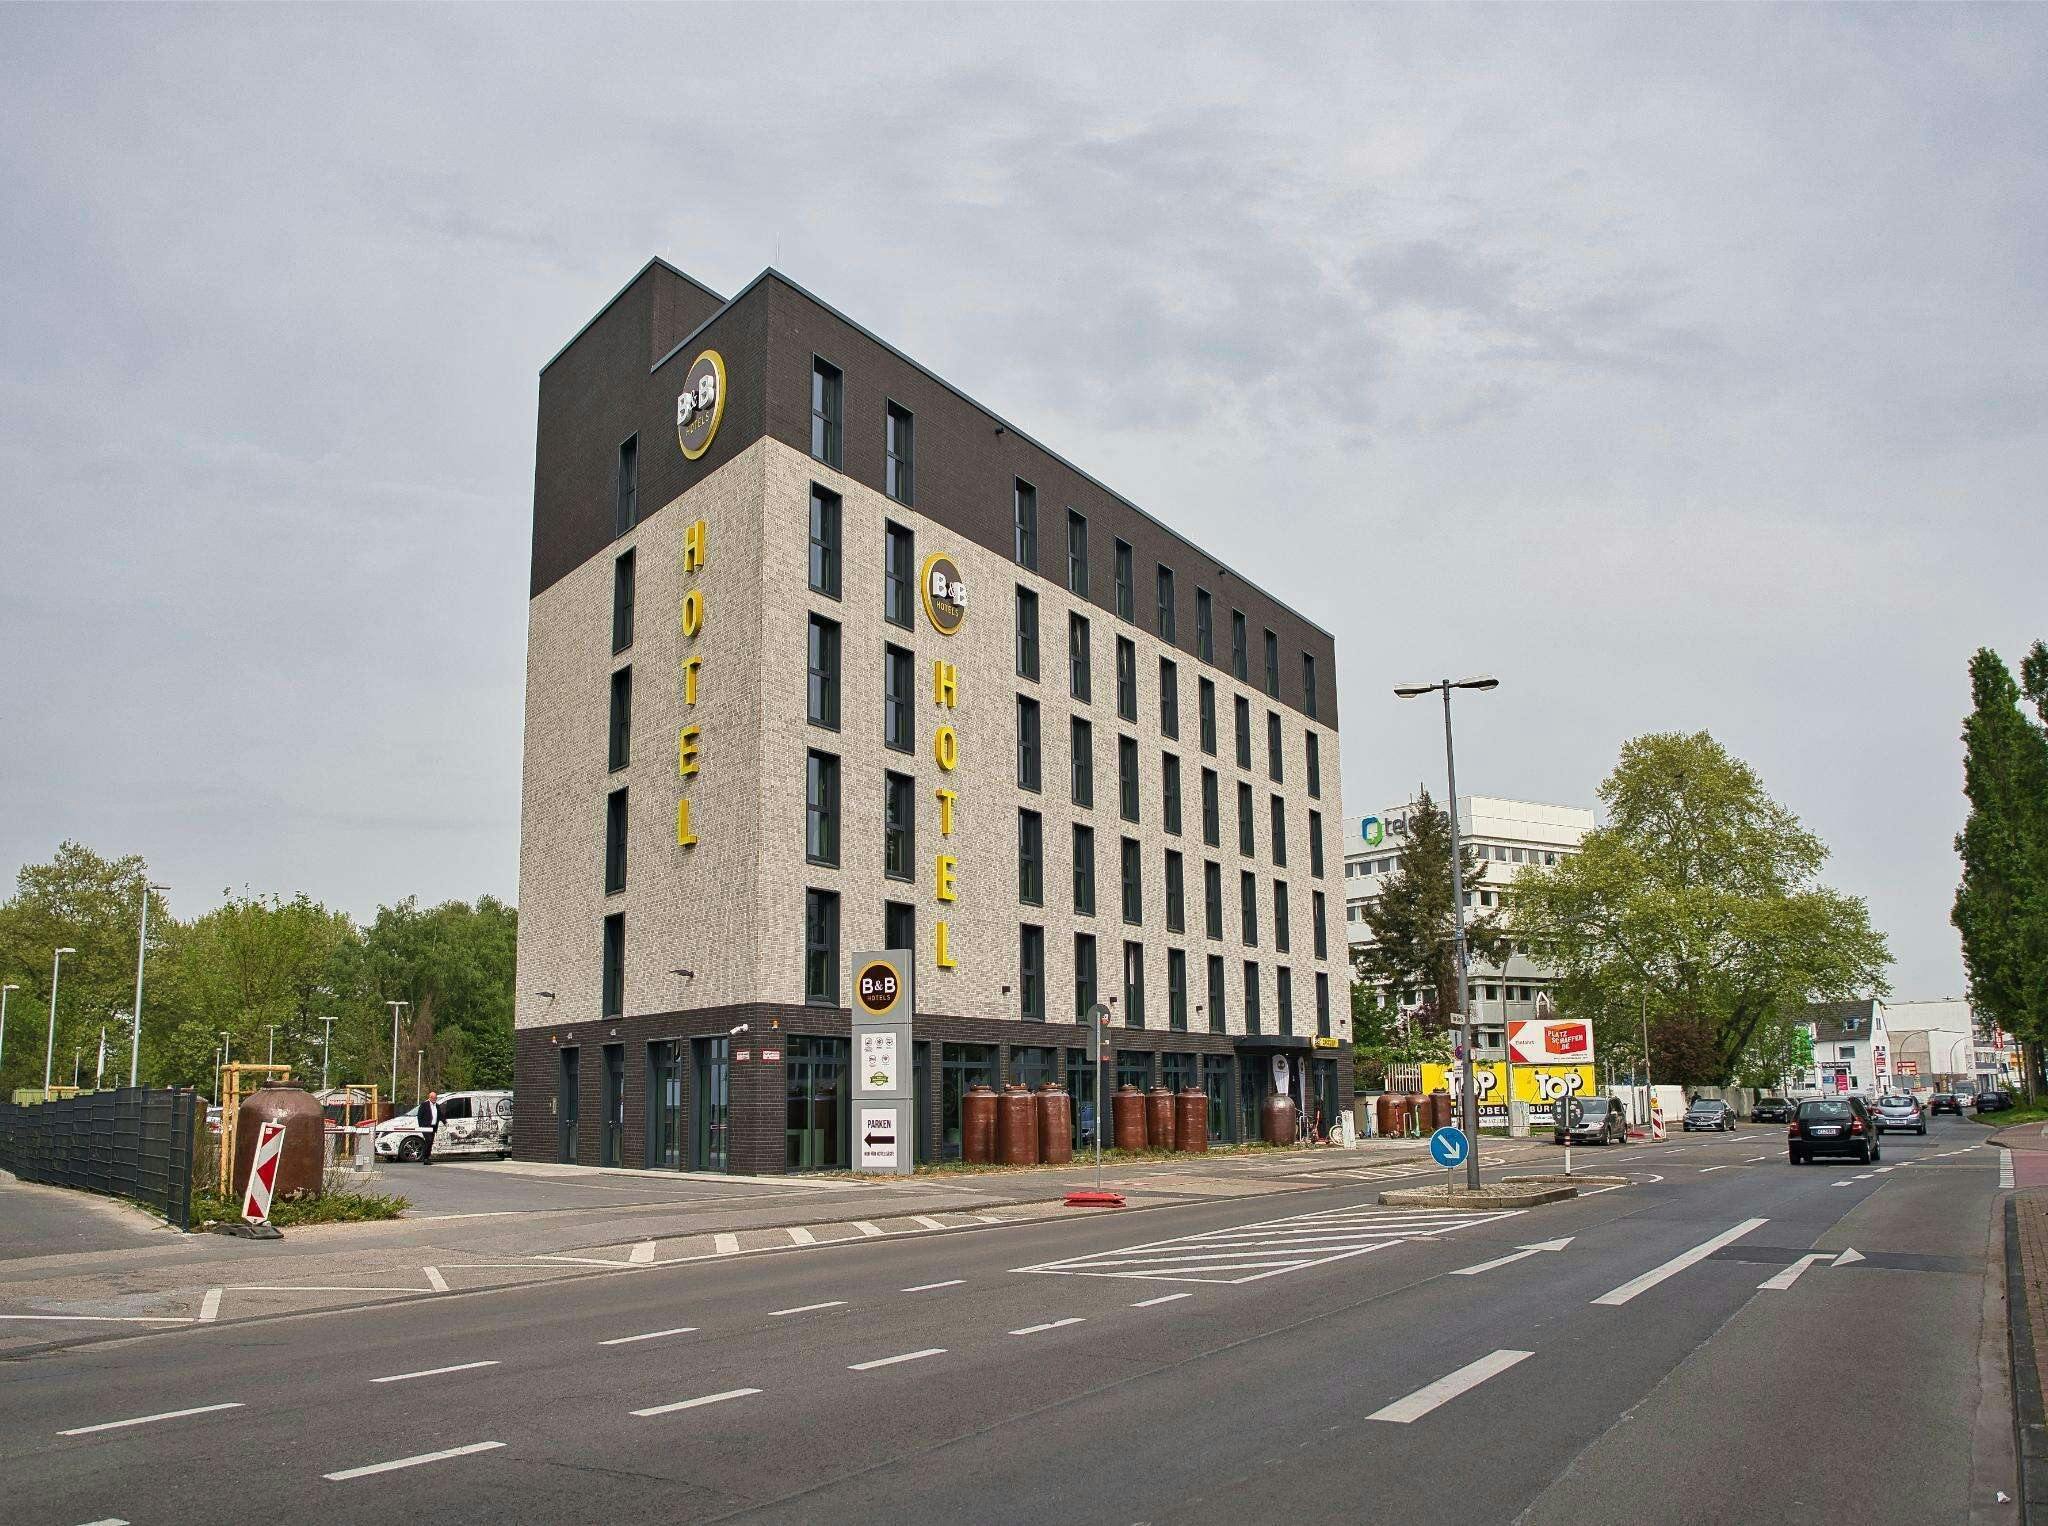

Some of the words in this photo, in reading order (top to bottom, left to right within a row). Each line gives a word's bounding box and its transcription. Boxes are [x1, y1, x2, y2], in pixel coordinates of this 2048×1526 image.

[678, 375, 714, 425] B&B
[933, 571, 967, 606] B&B
[937, 600, 959, 617] HOTELS
[678, 520, 705, 847] HOTEL
[935, 660, 958, 968] HOTEL
[863, 977, 896, 994] B&B
[1547, 1030, 1568, 1038] PLATZ
[1535, 1073, 1582, 1099] TOP
[867, 1119, 891, 1128] PARKEN
